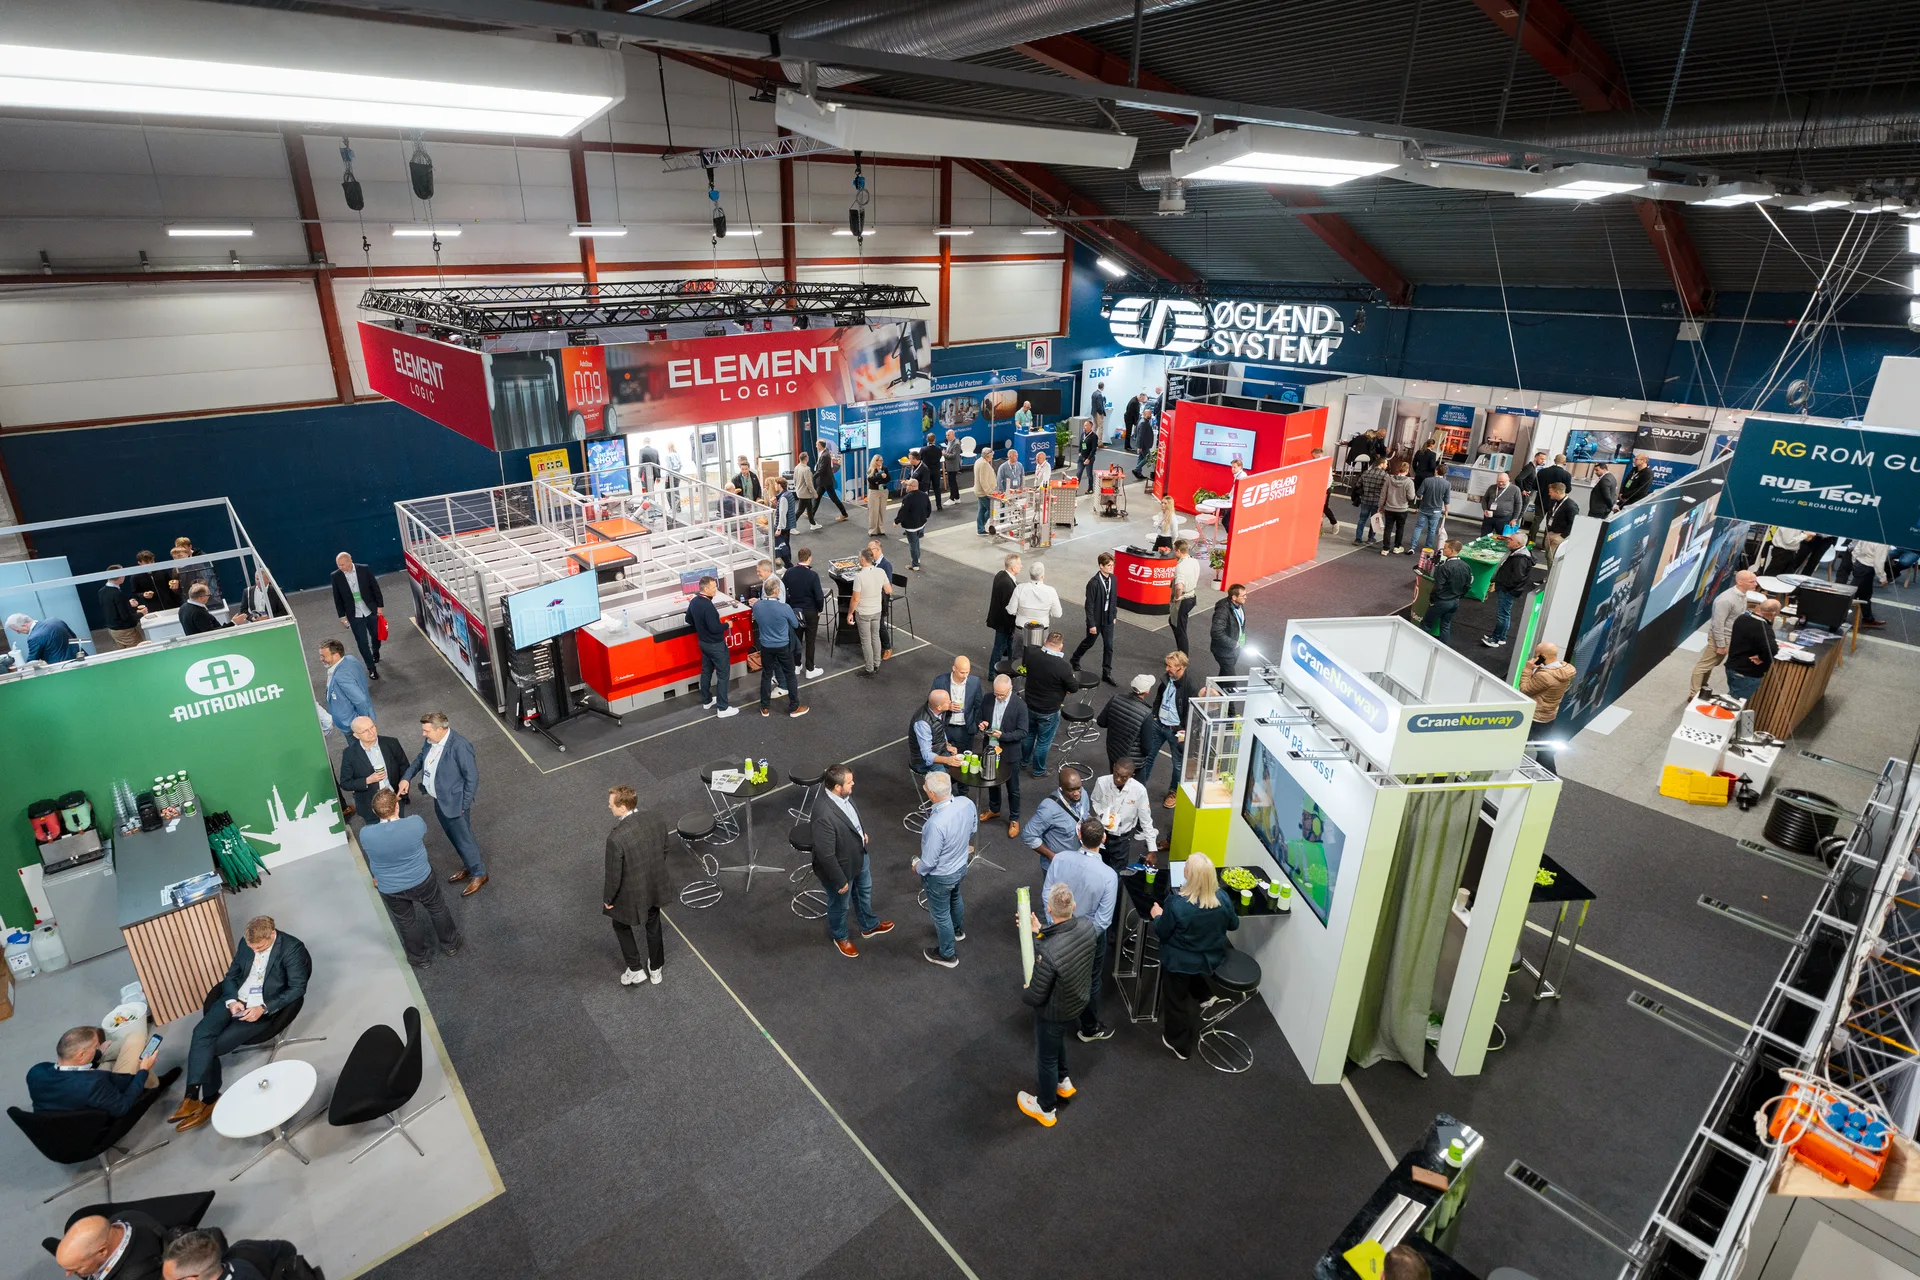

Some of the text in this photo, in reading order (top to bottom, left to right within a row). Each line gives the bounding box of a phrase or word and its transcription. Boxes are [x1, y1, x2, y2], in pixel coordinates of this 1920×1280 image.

[1213, 300, 1335, 334] ØGLÆND
[1212, 331, 1330, 365] SYSTEM
[392, 348, 444, 390] ELEMENT
[668, 346, 838, 388] ELEMENT
[1089, 366, 1113, 379] SKF
[410, 381, 435, 403] LOGIC
[573, 370, 602, 405] 009
[720, 381, 797, 401] LOGIC
[1651, 428, 1700, 440] SMART
[1771, 440, 1806, 458] RG
[1811, 444, 1875, 468] ROM
[1652, 466, 1673, 474] ARE
[1269, 485, 1296, 501] SYSTEM
[1828, 505, 1857, 513] GUMMI
[1297, 641, 1379, 723] CraneNorway
[169, 684, 284, 723] AUTRONICA
[1416, 713, 1515, 729] CraneNorway
